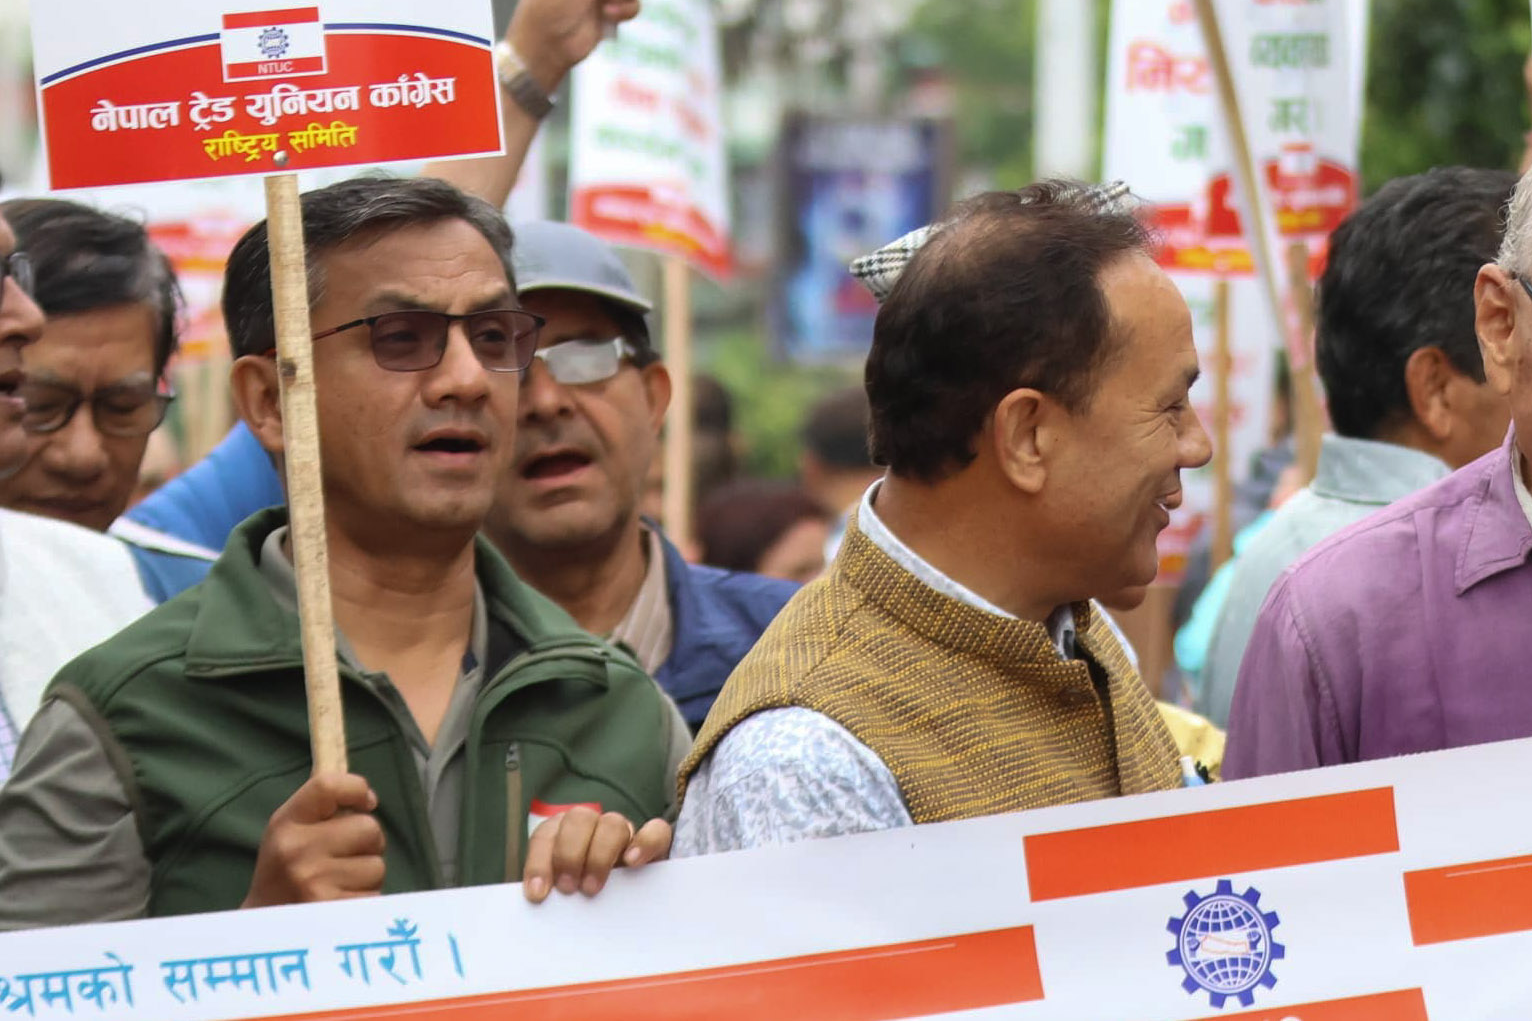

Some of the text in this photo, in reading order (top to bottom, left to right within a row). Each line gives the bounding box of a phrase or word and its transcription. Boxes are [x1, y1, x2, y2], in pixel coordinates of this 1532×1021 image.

[257, 61, 294, 75] NTUC
[90, 99, 181, 132] नेपाल
[188, 91, 237, 131] ट्रेड
[245, 82, 361, 126] युनियन
[288, 120, 358, 154] समिति
[0, 952, 137, 1016] श्रमको
[159, 947, 312, 1002] सम्मान
